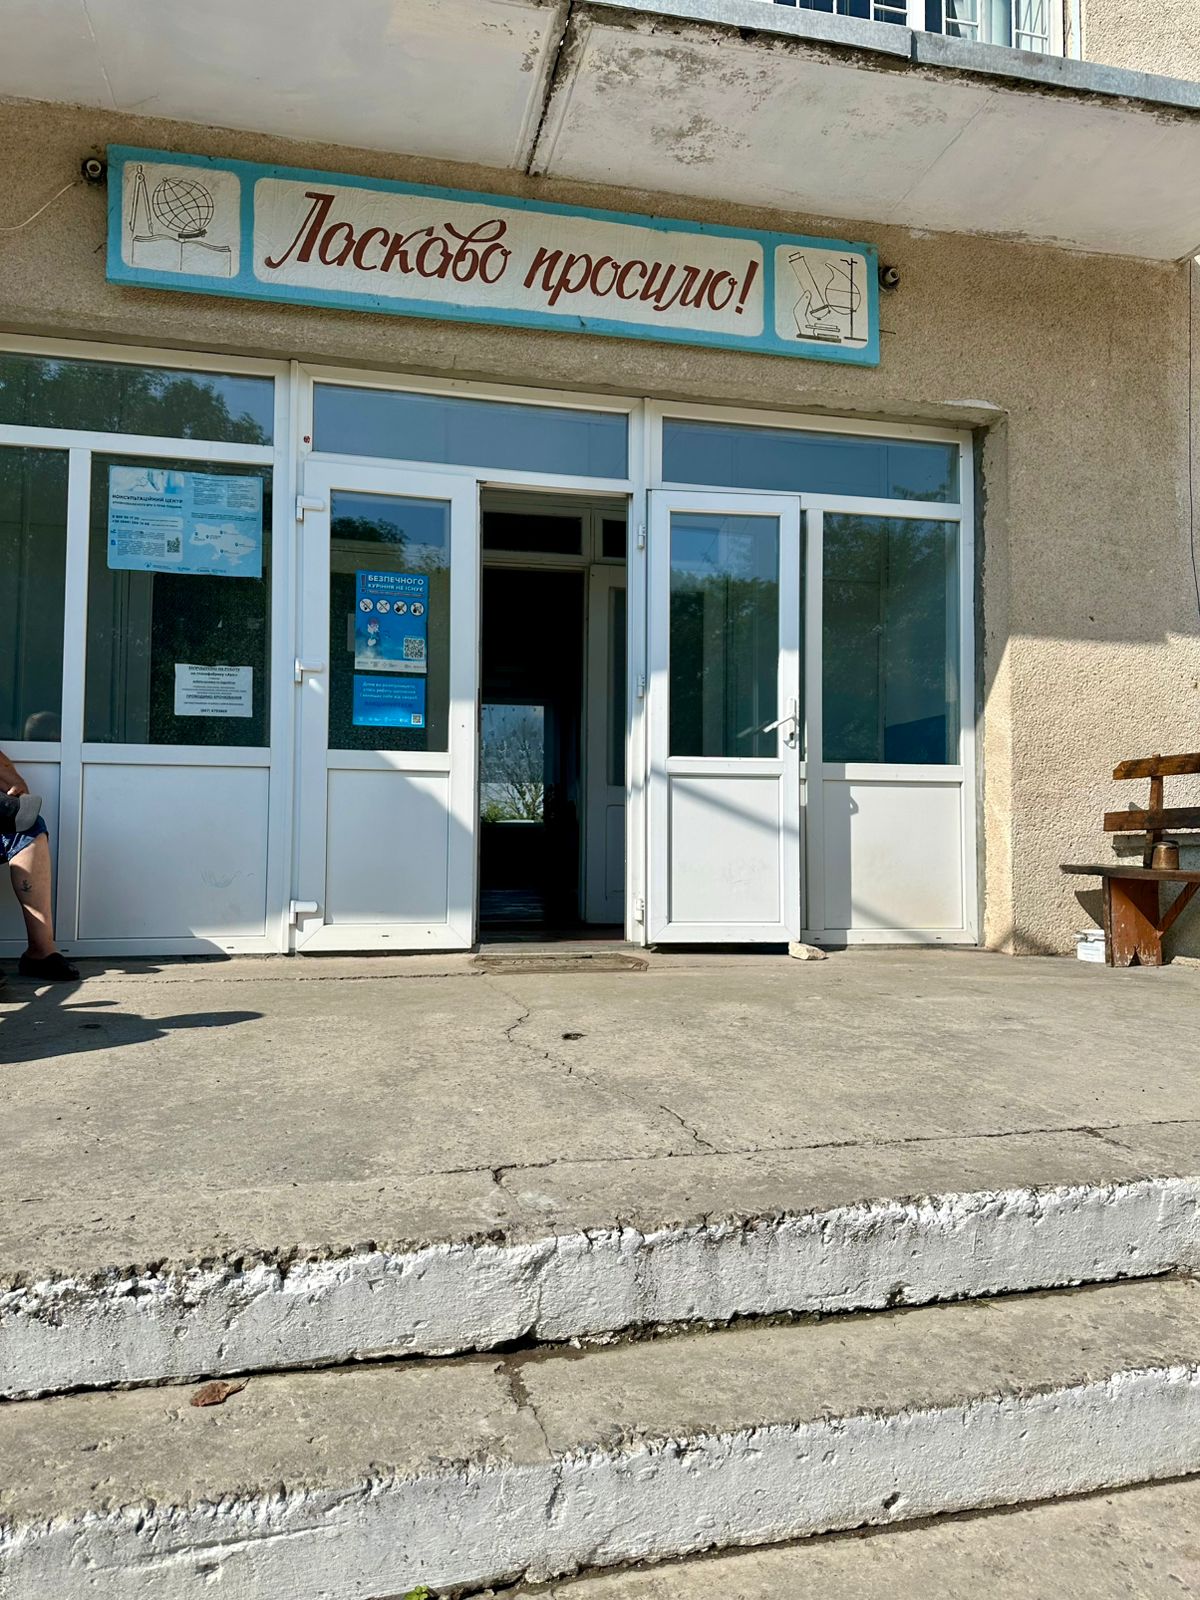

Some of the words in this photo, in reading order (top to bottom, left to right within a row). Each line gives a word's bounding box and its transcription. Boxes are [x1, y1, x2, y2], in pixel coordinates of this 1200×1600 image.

[264, 191, 512, 284] Ласкаво
[523, 246, 760, 315] просимо!
[367, 574, 424, 586] БЕЗПЕЧНОГО
[367, 583, 395, 591] КУРІННЯ
